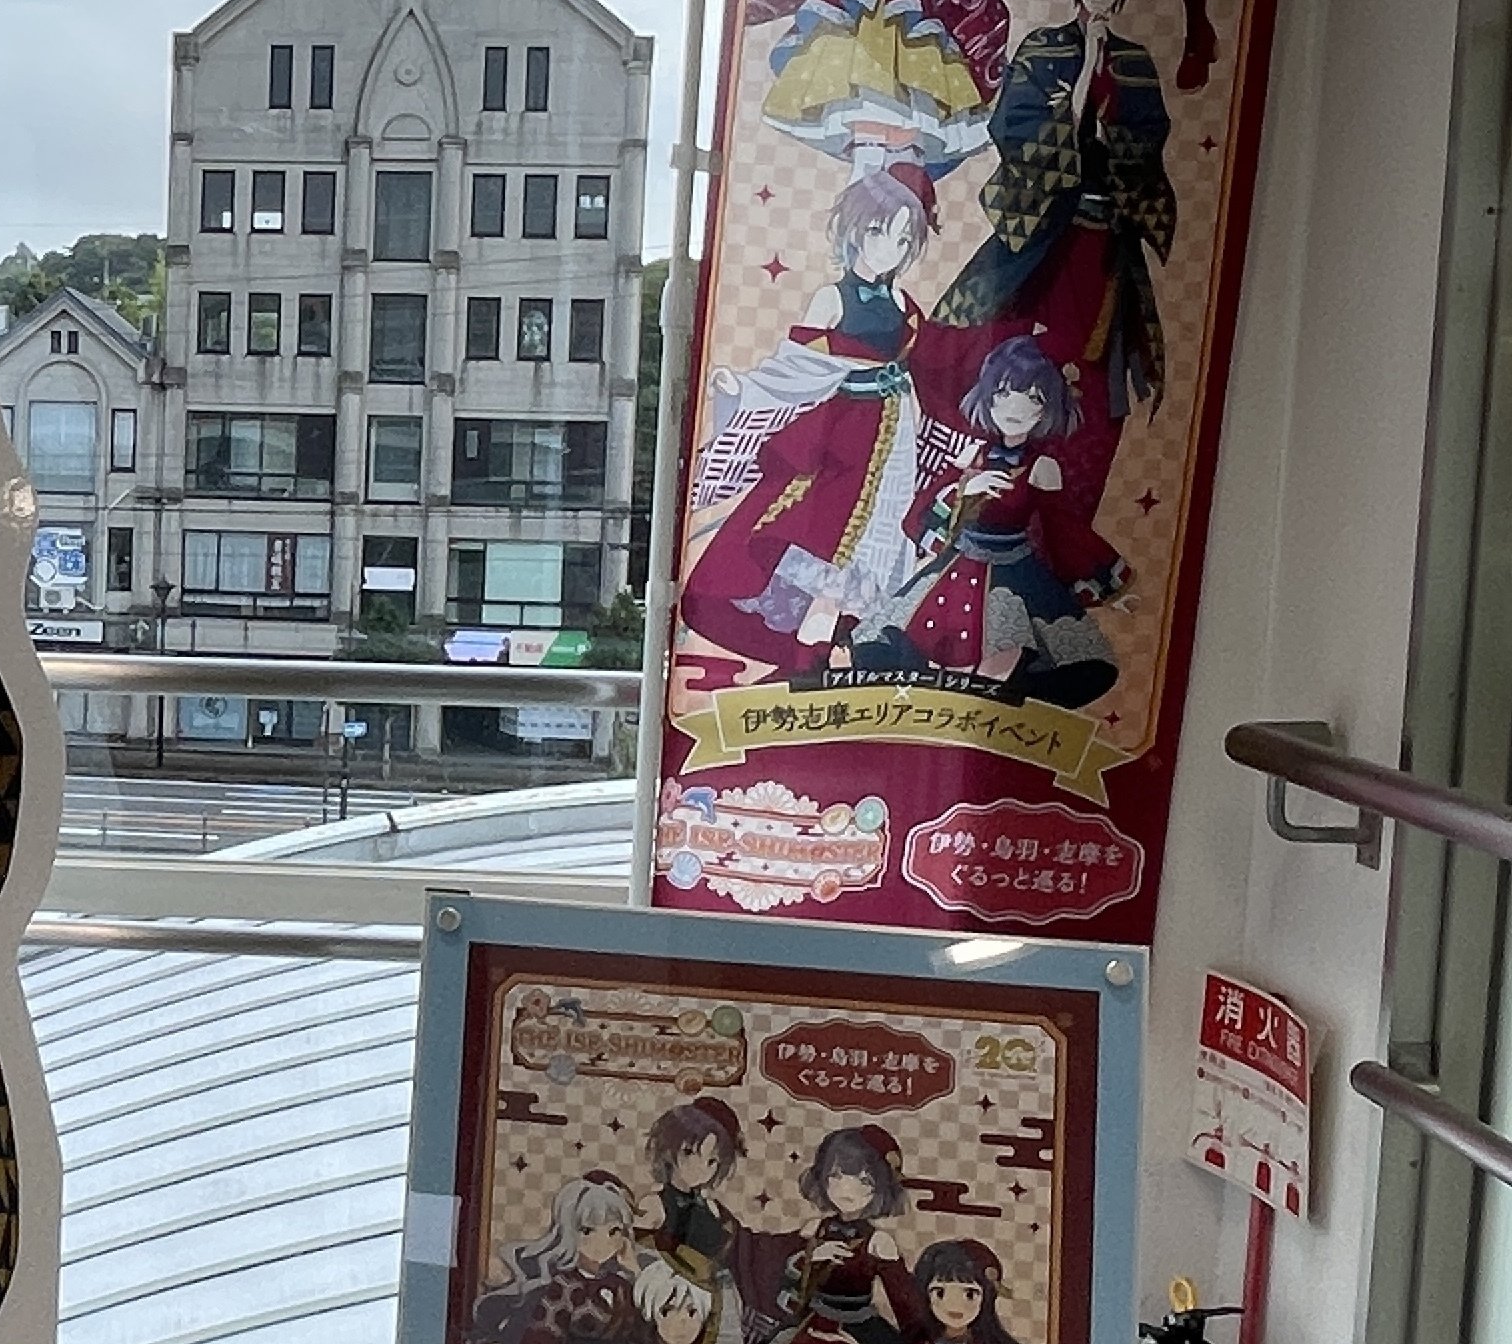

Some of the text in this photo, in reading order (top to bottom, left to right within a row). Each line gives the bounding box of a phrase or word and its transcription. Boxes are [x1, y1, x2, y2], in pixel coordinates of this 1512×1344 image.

[740, 702, 1063, 755] 伊勢志摩エリアコラボイベント
